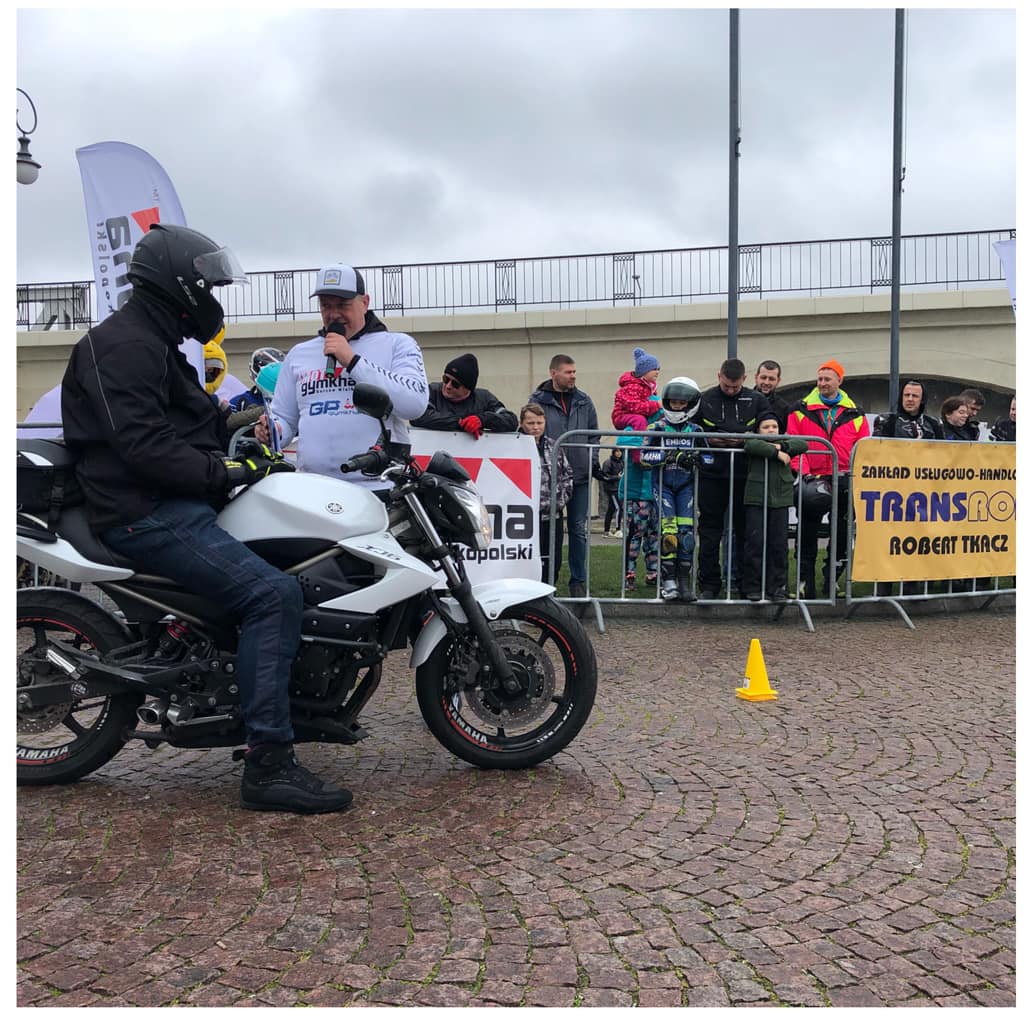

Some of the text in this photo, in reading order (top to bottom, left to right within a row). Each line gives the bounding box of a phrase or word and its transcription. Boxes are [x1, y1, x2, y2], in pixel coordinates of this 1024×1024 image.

[301, 376, 357, 397] gymkha
[309, 400, 340, 416] GP
[861, 466, 911, 479] ZAKŁAD
[860, 490, 1016, 522] TRANSRO
[460, 543, 533, 565] kopolski
[889, 534, 1009, 556] ROBERT TKACZ
[448, 704, 489, 744] YAMAHA
